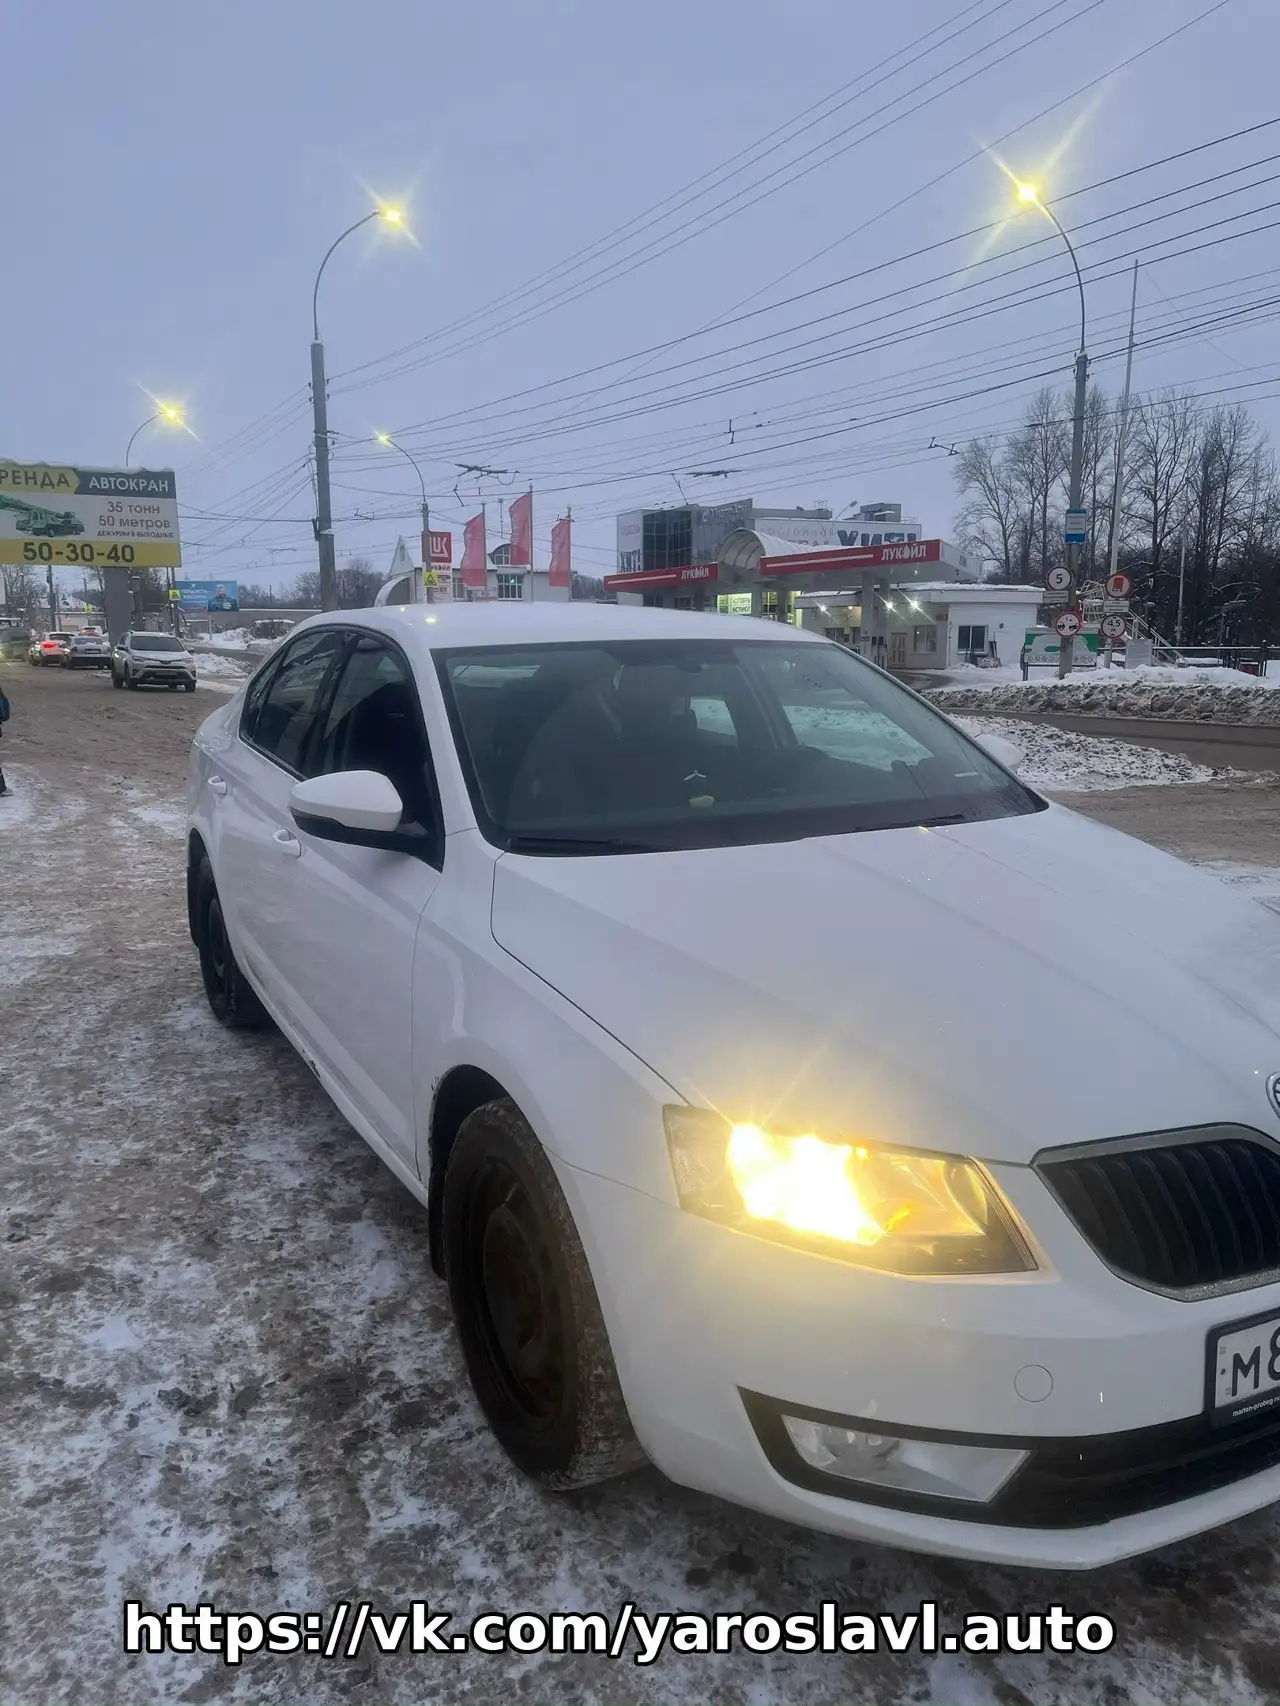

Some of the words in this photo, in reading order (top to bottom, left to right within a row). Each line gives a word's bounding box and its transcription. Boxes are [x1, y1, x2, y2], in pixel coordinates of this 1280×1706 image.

[0, 469, 71, 489] РЕНДА
[89, 476, 169, 492] АВТОКРАН
[107, 501, 123, 513] 35
[128, 504, 160, 515] тонн
[98, 515, 116, 527] 50
[119, 518, 171, 530] метров
[97, 530, 130, 538] ДЕЖУРИМ
[23, 542, 136, 563] 50-30-40
[881, 544, 926, 561] ЛУКОЙЛ
[681, 567, 709, 580] ЛУКОЙЛ
[1055, 573, 1064, 584] 5
